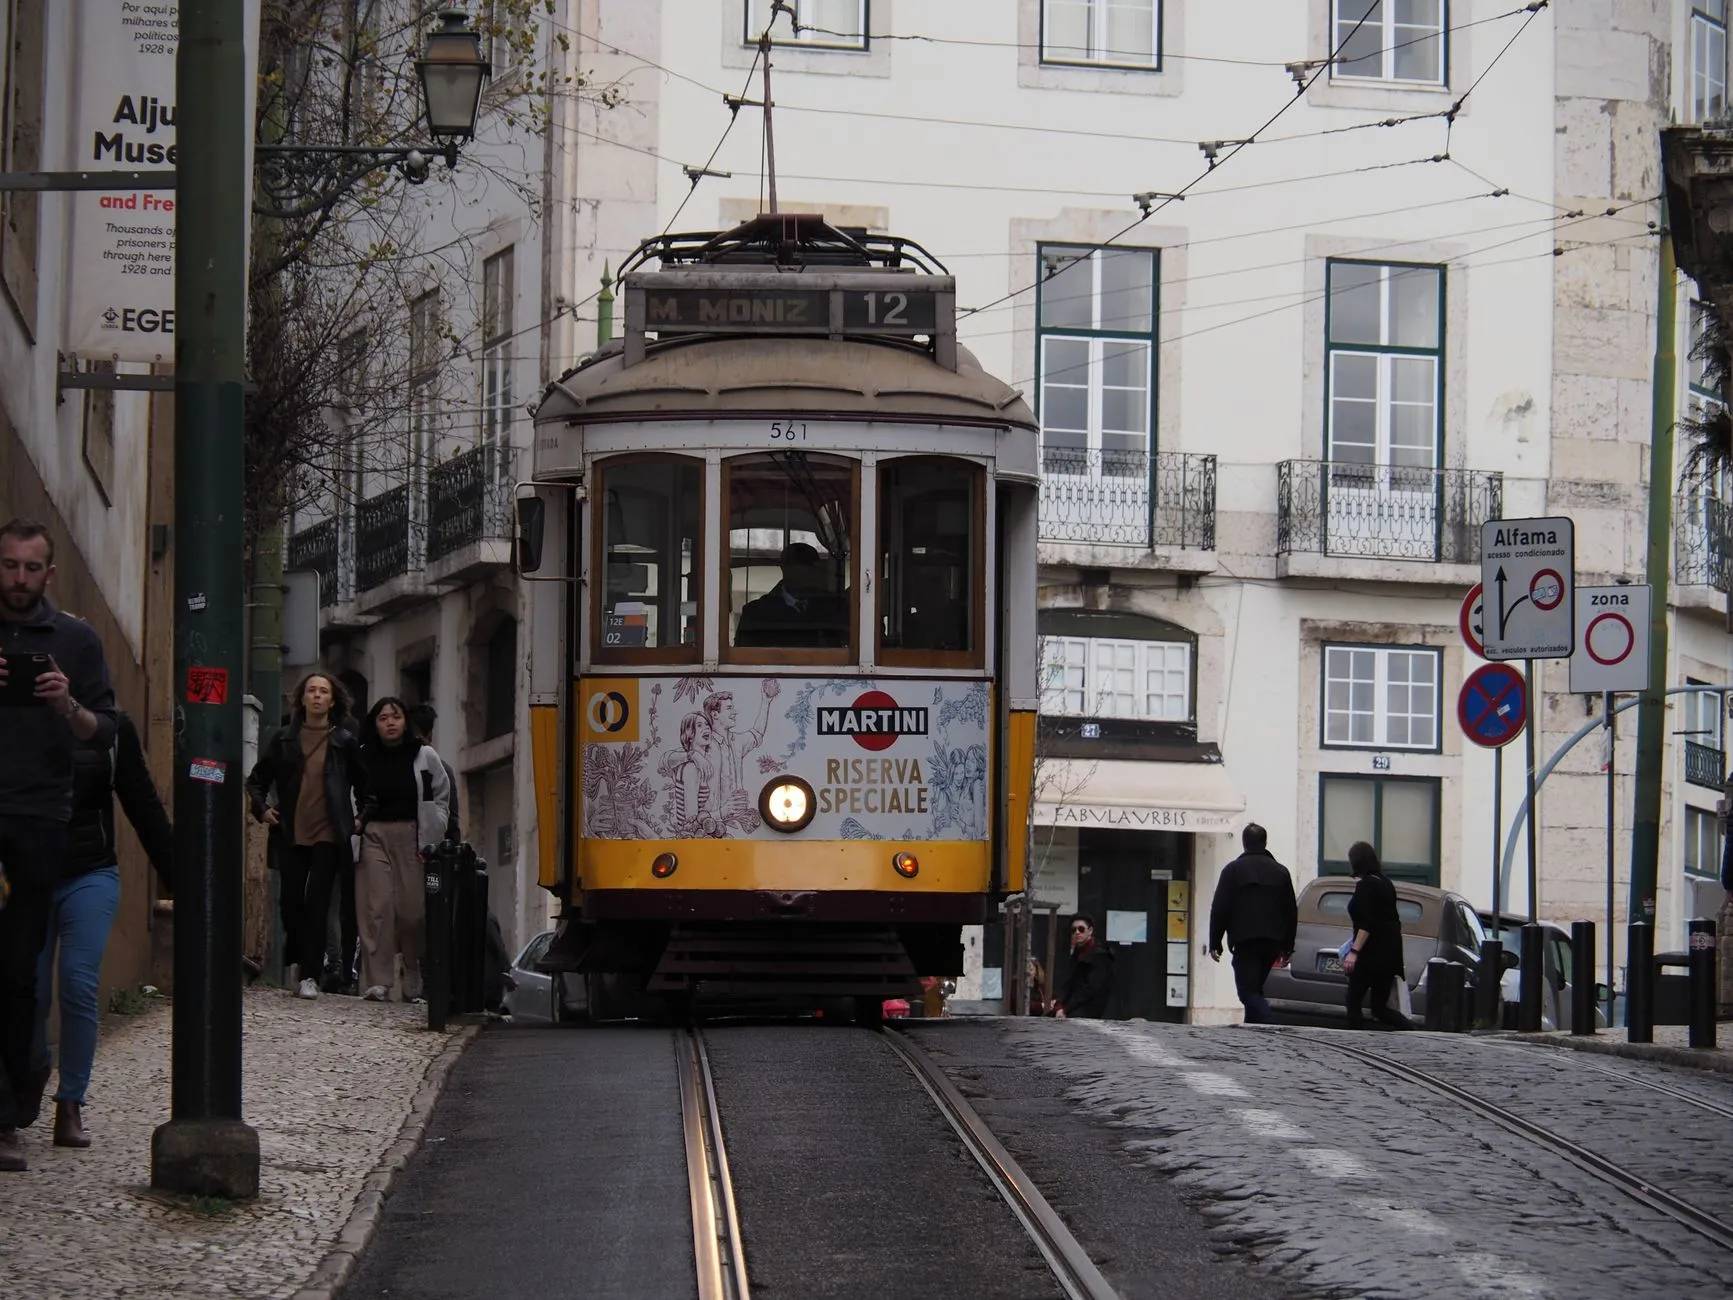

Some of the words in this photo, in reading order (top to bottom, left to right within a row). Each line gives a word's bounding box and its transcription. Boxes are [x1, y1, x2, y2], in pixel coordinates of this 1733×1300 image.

[122, 2, 140, 12] Por
[143, 5, 167, 15] aqui
[122, 16, 168, 27] milhares
[138, 43, 164, 54] 1928
[112, 95, 176, 134] Alju
[94, 131, 177, 164] Muse
[100, 194, 137, 210] and
[143, 194, 174, 211] Fre
[106, 222, 163, 235] Thousands
[116, 238, 166, 249] prisoners
[103, 250, 145, 262] through
[147, 252, 172, 262] here
[121, 264, 148, 274] 1928
[150, 266, 172, 275] and
[650, 298, 682, 321] M.
[700, 298, 808, 322] MONIZ
[864, 292, 908, 325] 12
[122, 308, 176, 333] EGE
[770, 422, 807, 441] 561
[1494, 528, 1557, 547] Alfama
[1487, 551, 1511, 560] acesso
[1515, 549, 1565, 558] condicionado
[1592, 594, 1629, 606] zona
[610, 617, 624, 626] 12E
[606, 632, 621, 644] 02
[821, 710, 925, 732] MARTINI
[1084, 724, 1096, 736] 27
[1375, 756, 1388, 768] 29
[827, 758, 922, 785] RISERVA
[820, 788, 928, 814] SPECIALE
